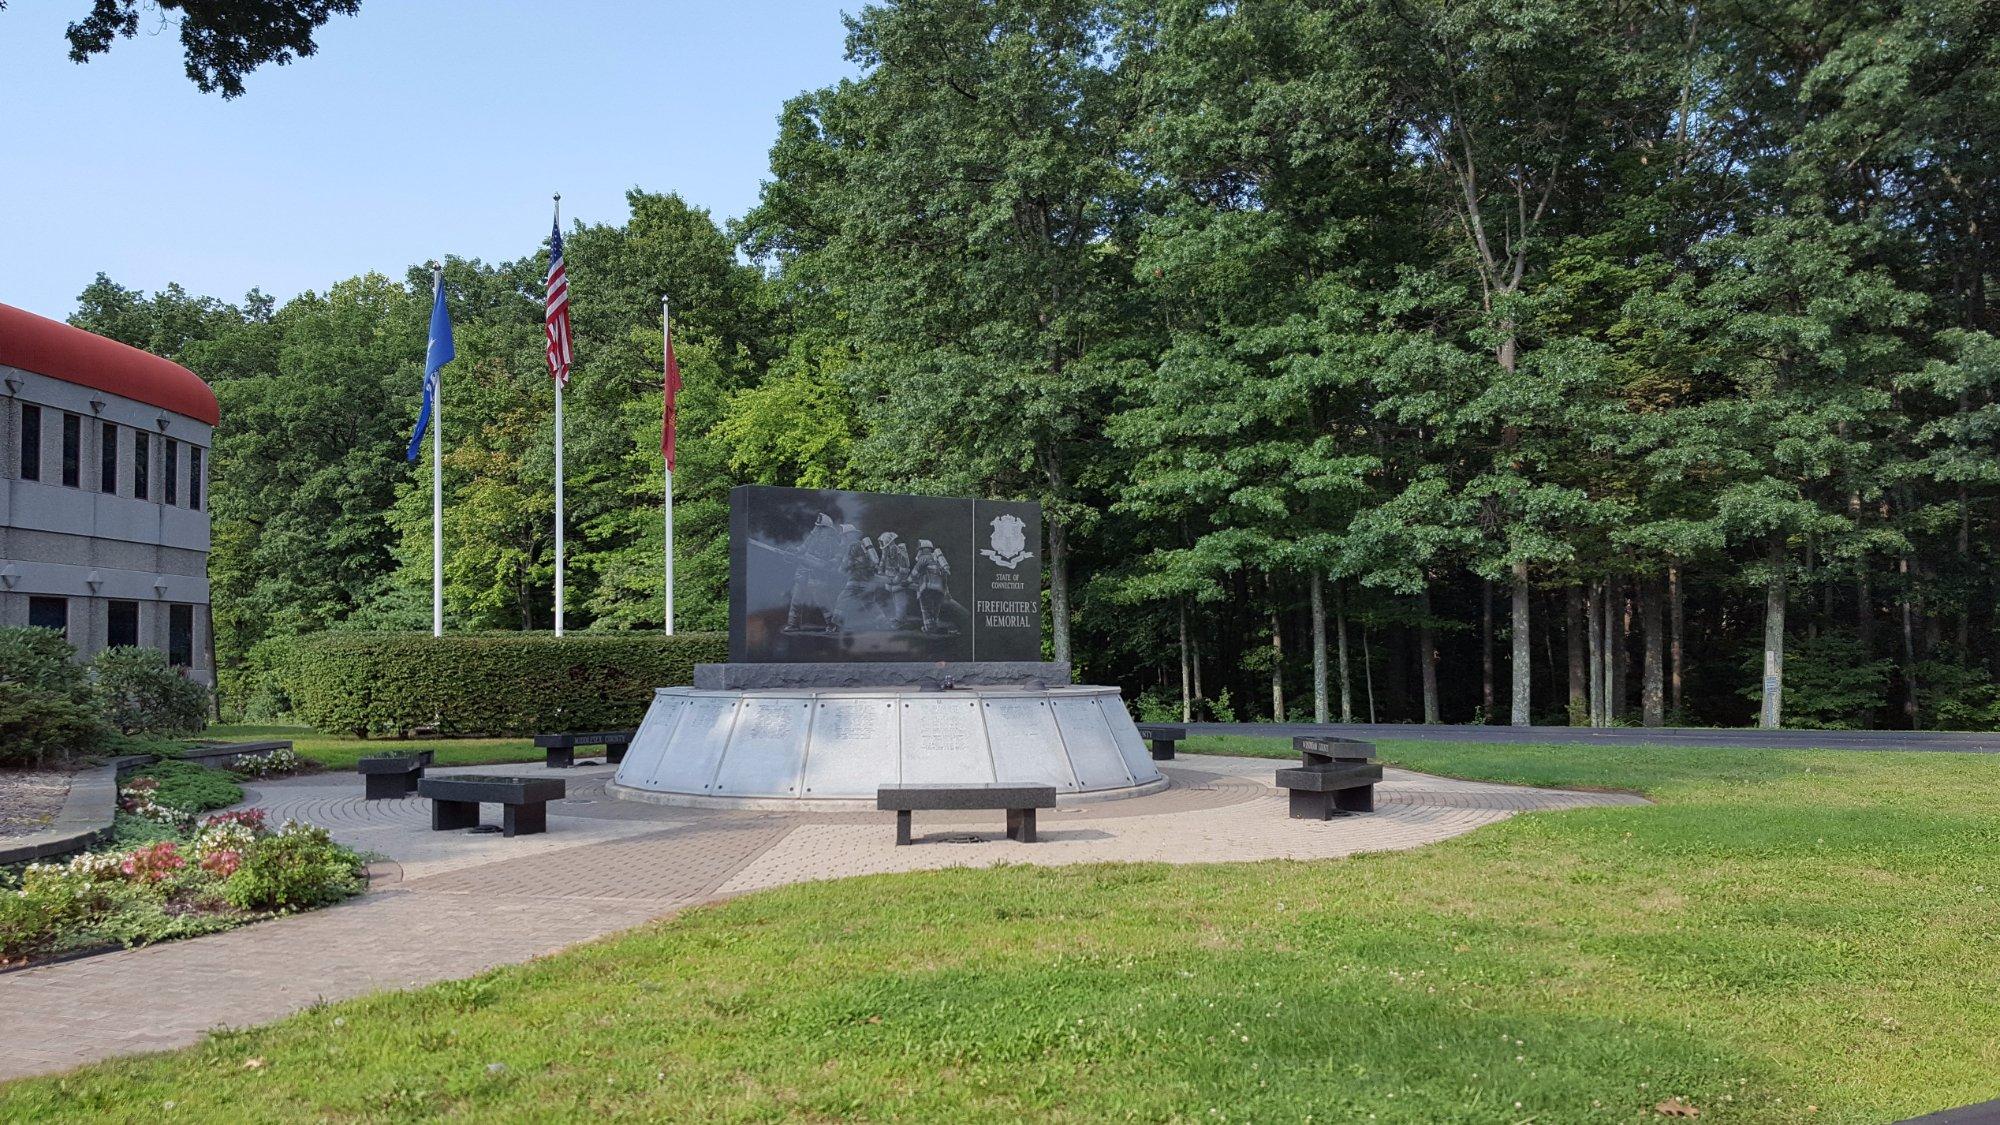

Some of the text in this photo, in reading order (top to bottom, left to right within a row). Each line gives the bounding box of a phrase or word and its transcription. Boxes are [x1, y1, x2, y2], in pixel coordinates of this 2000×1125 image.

[996, 573, 1011, 581] STATE
[991, 582, 1024, 590] CONNECTICUT
[977, 600, 1037, 613] FIREFIGHTER'S
[986, 615, 1031, 627] MEMORIAL
